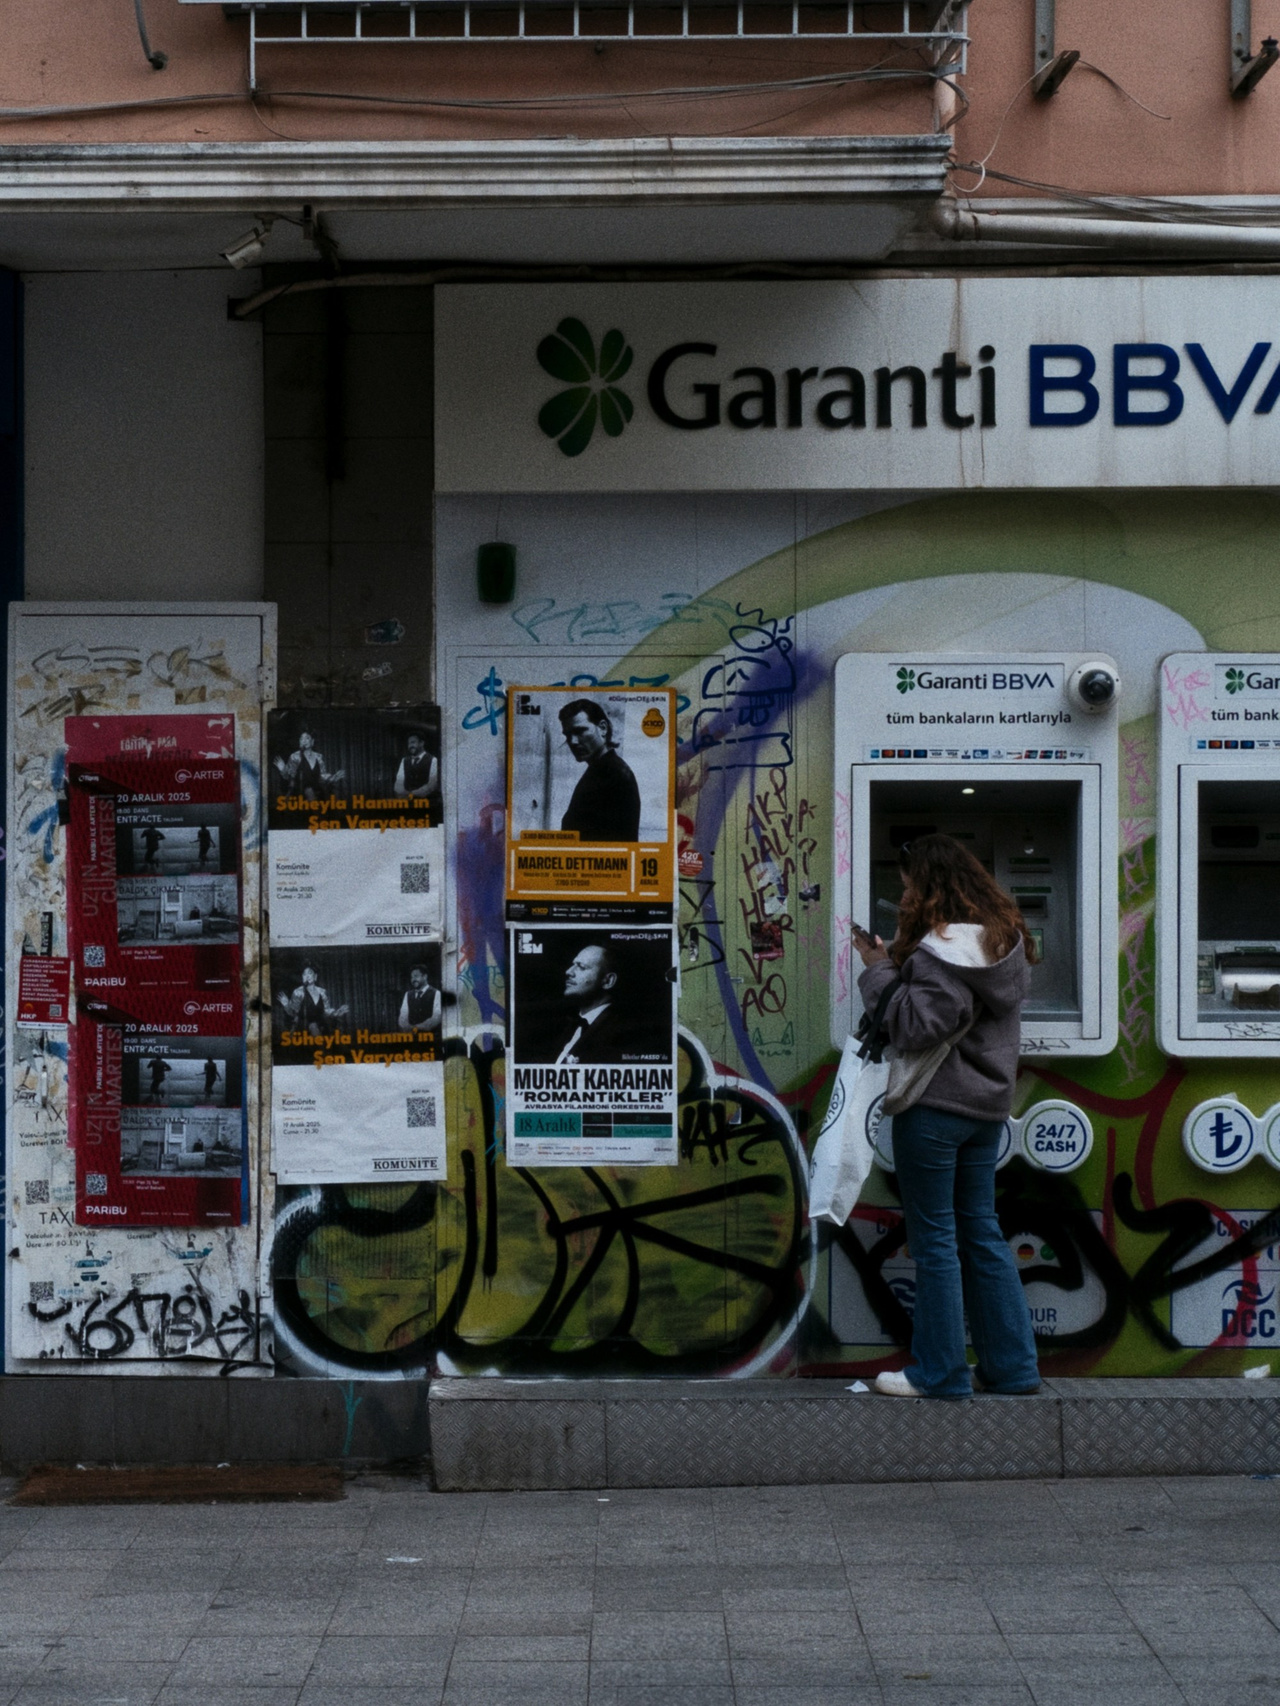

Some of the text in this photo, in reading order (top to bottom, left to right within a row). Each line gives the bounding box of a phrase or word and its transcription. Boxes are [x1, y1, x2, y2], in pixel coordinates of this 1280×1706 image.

[648, 343, 997, 431] Garanti
[917, 672, 1054, 690] Garanti BBVA
[886, 711, 1072, 727] tüm bankaların kartlarıyla
[1211, 709, 1239, 720] tüm
[193, 770, 224, 780] ARTER
[117, 791, 191, 803] 20 ARALIK 2025
[276, 793, 430, 815] Süheyla Hanım'ın
[308, 814, 431, 835] Şen Varyetesi
[518, 856, 628, 871] MARCEL DETTMANN
[641, 858, 658, 877] 19
[202, 1003, 233, 1013] ARTER
[125, 1024, 199, 1033] 20 ARALIK 2025
[280, 1028, 434, 1049] Süheyla Hanım'ın
[313, 1048, 435, 1070] Şen Varyetesi
[514, 1069, 673, 1090] MURAT KARAHAN
[536, 1117, 577, 1133] Aralık
[1035, 1124, 1076, 1139] 24/7
[1035, 1140, 1076, 1152] CASH
[1222, 1309, 1275, 1338] DCC
